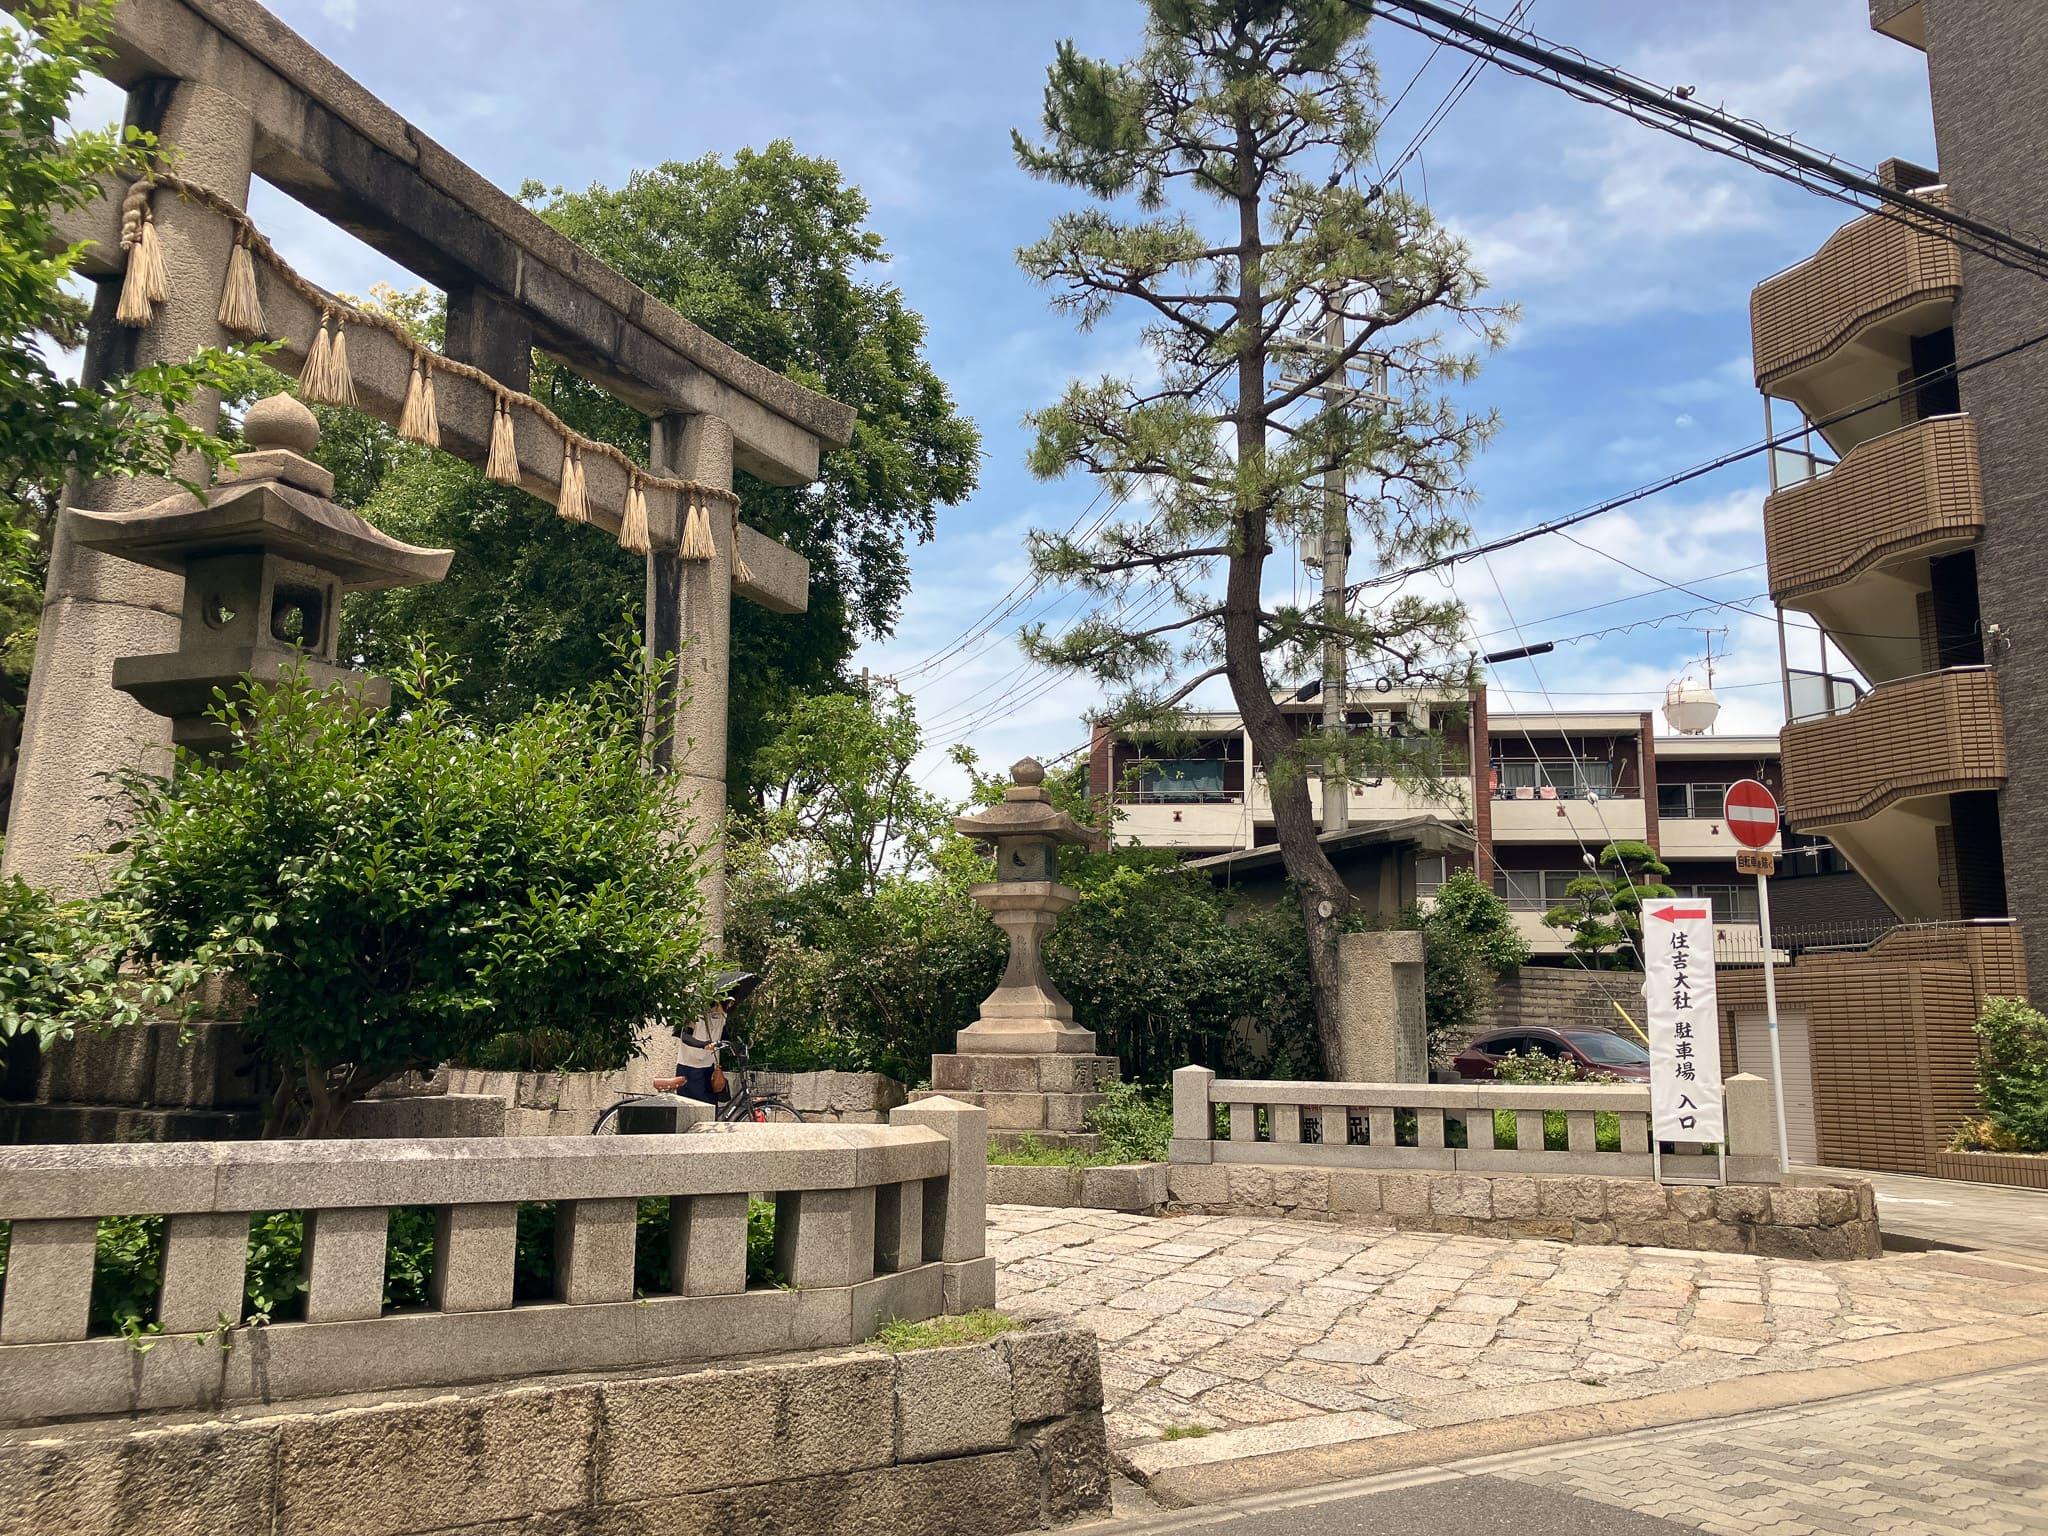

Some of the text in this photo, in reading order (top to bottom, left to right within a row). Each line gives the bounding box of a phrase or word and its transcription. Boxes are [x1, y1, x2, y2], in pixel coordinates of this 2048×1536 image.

[1670, 931, 1698, 1130] 住吉大社 駐車場 入口
